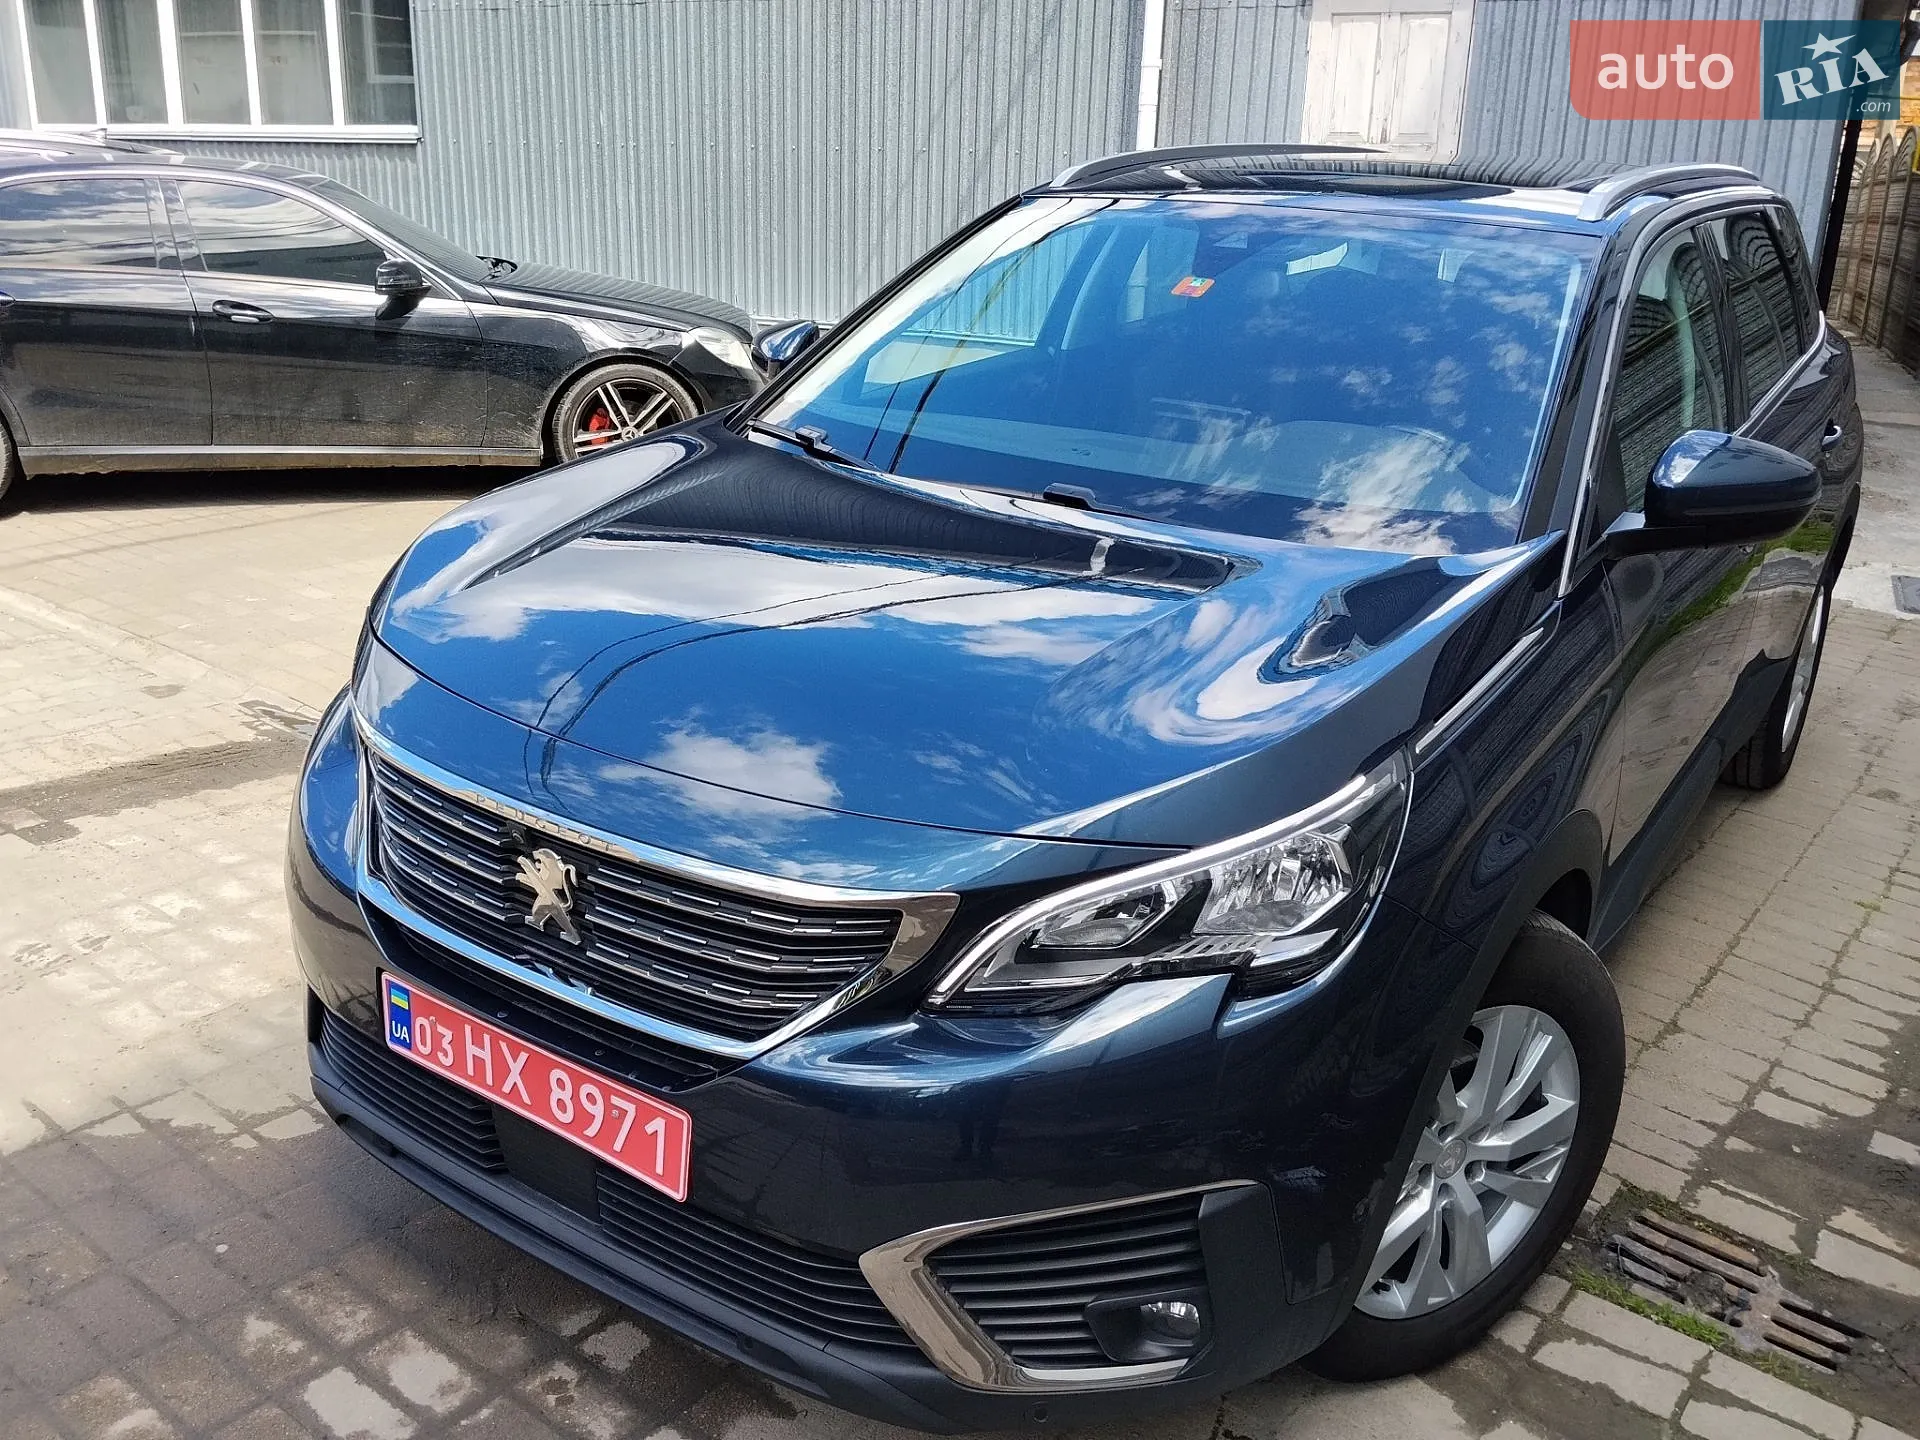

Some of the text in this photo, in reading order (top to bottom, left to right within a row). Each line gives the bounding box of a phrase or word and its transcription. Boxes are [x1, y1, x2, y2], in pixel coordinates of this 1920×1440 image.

[476, 793, 617, 852] PEUGEOT
[391, 1020, 410, 1044] UA
[414, 1015, 667, 1177] 03 HX 8971
